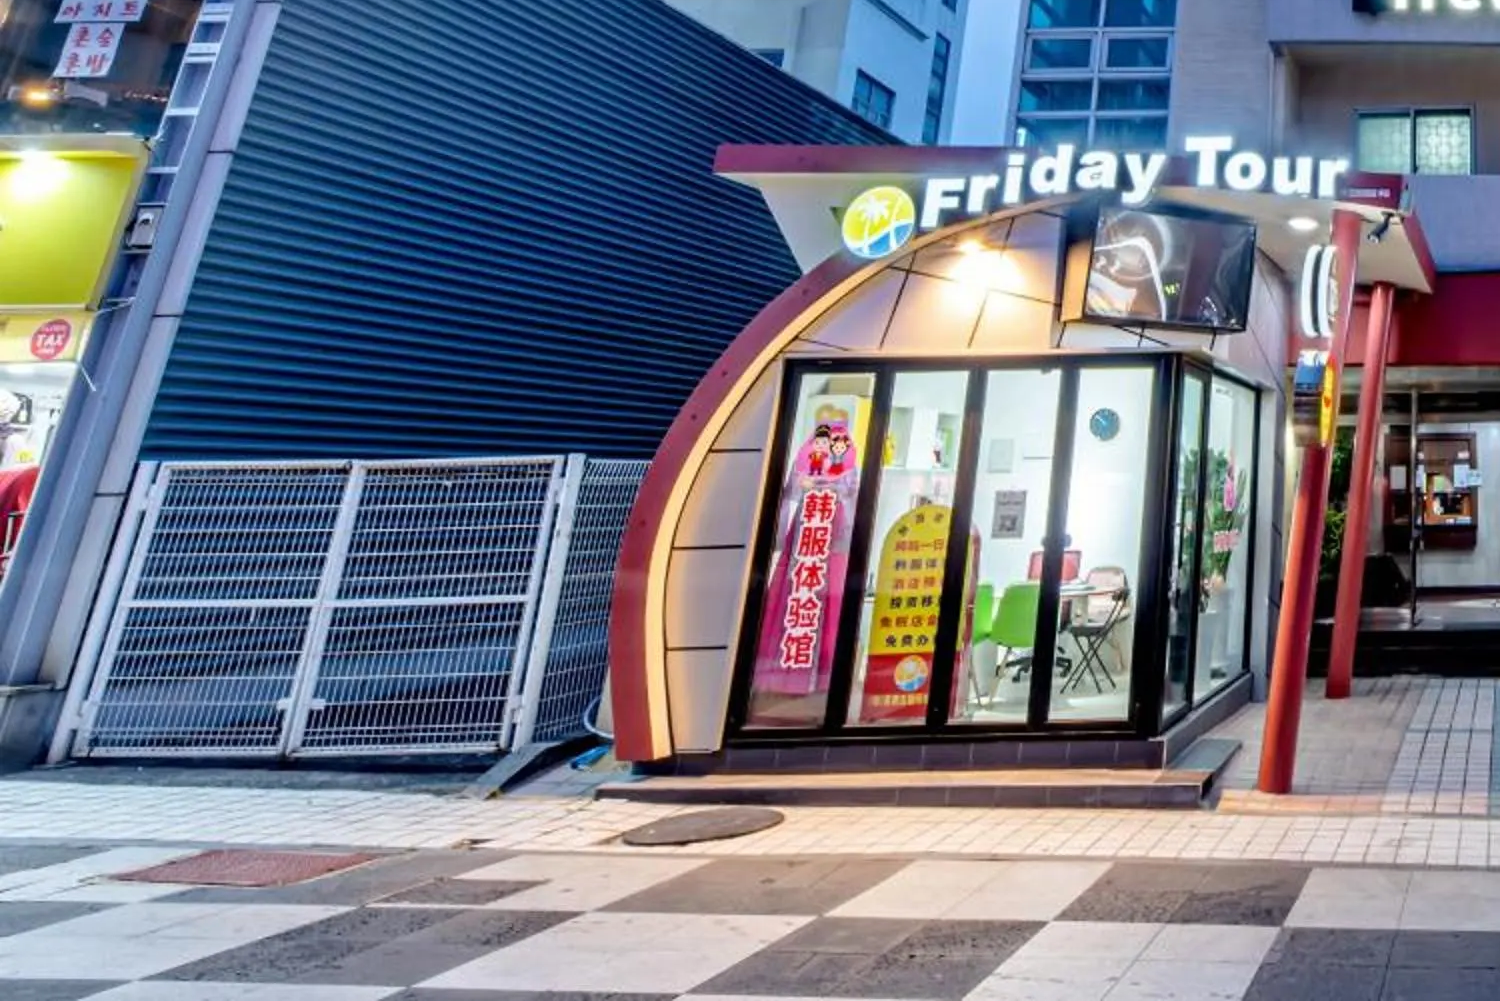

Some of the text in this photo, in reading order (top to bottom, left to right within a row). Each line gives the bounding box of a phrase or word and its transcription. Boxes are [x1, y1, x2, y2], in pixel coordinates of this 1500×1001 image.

[920, 136, 1351, 229] Friday Tour
[780, 490, 836, 669] 韩服体验馆
[890, 595, 940, 609] 投资移
[885, 634, 936, 648] 免费办
